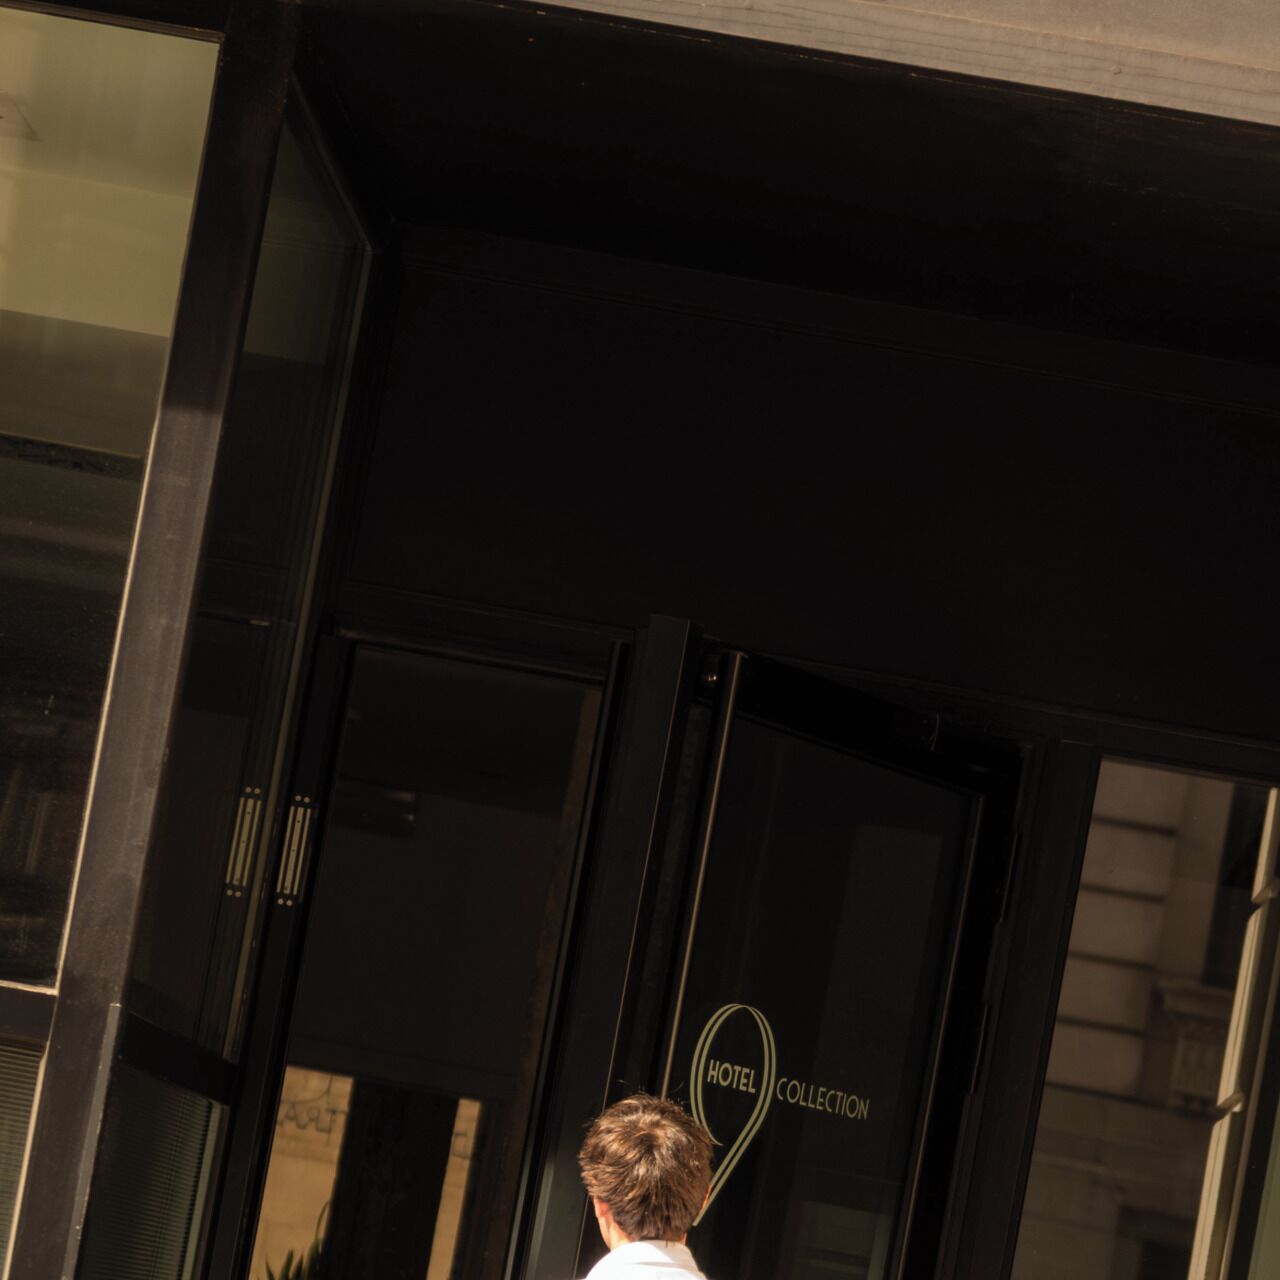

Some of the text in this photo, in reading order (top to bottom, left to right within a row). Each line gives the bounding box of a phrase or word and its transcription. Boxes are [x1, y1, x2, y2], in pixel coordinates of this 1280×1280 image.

[689, 1003, 870, 1226] 9 HOTEL COLLECTION
